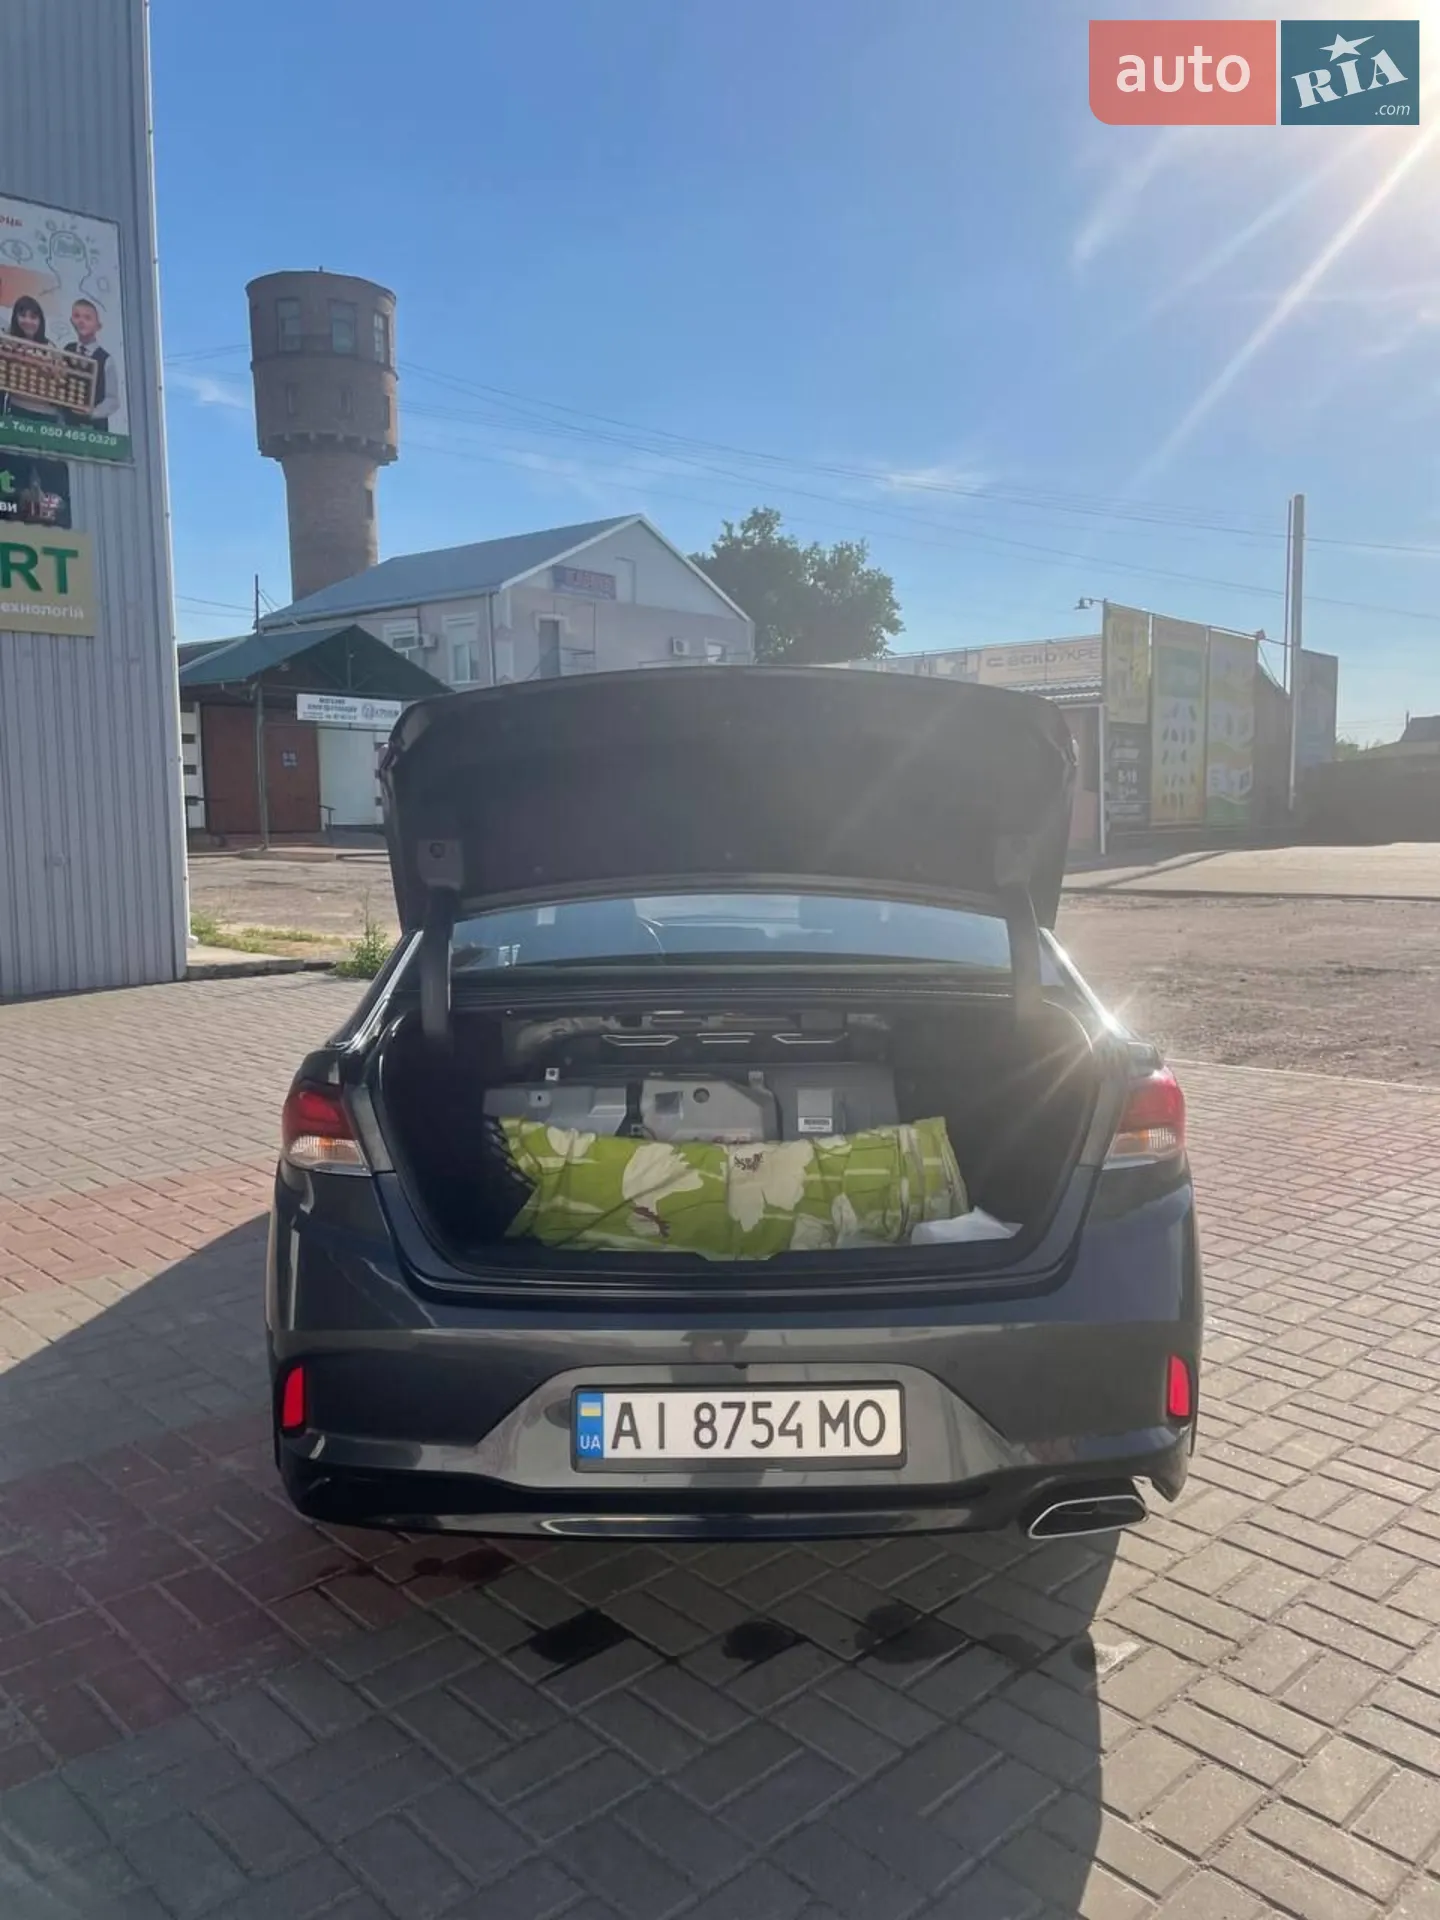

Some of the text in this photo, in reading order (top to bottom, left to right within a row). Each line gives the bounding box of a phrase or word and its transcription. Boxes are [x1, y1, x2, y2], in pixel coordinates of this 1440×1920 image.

[12, 420, 37, 434] Тел.
[40, 425, 62, 437] 050
[0, 542, 79, 594] RT
[611, 1399, 886, 1450] AI 8754 MO
[579, 1434, 601, 1450] UA
